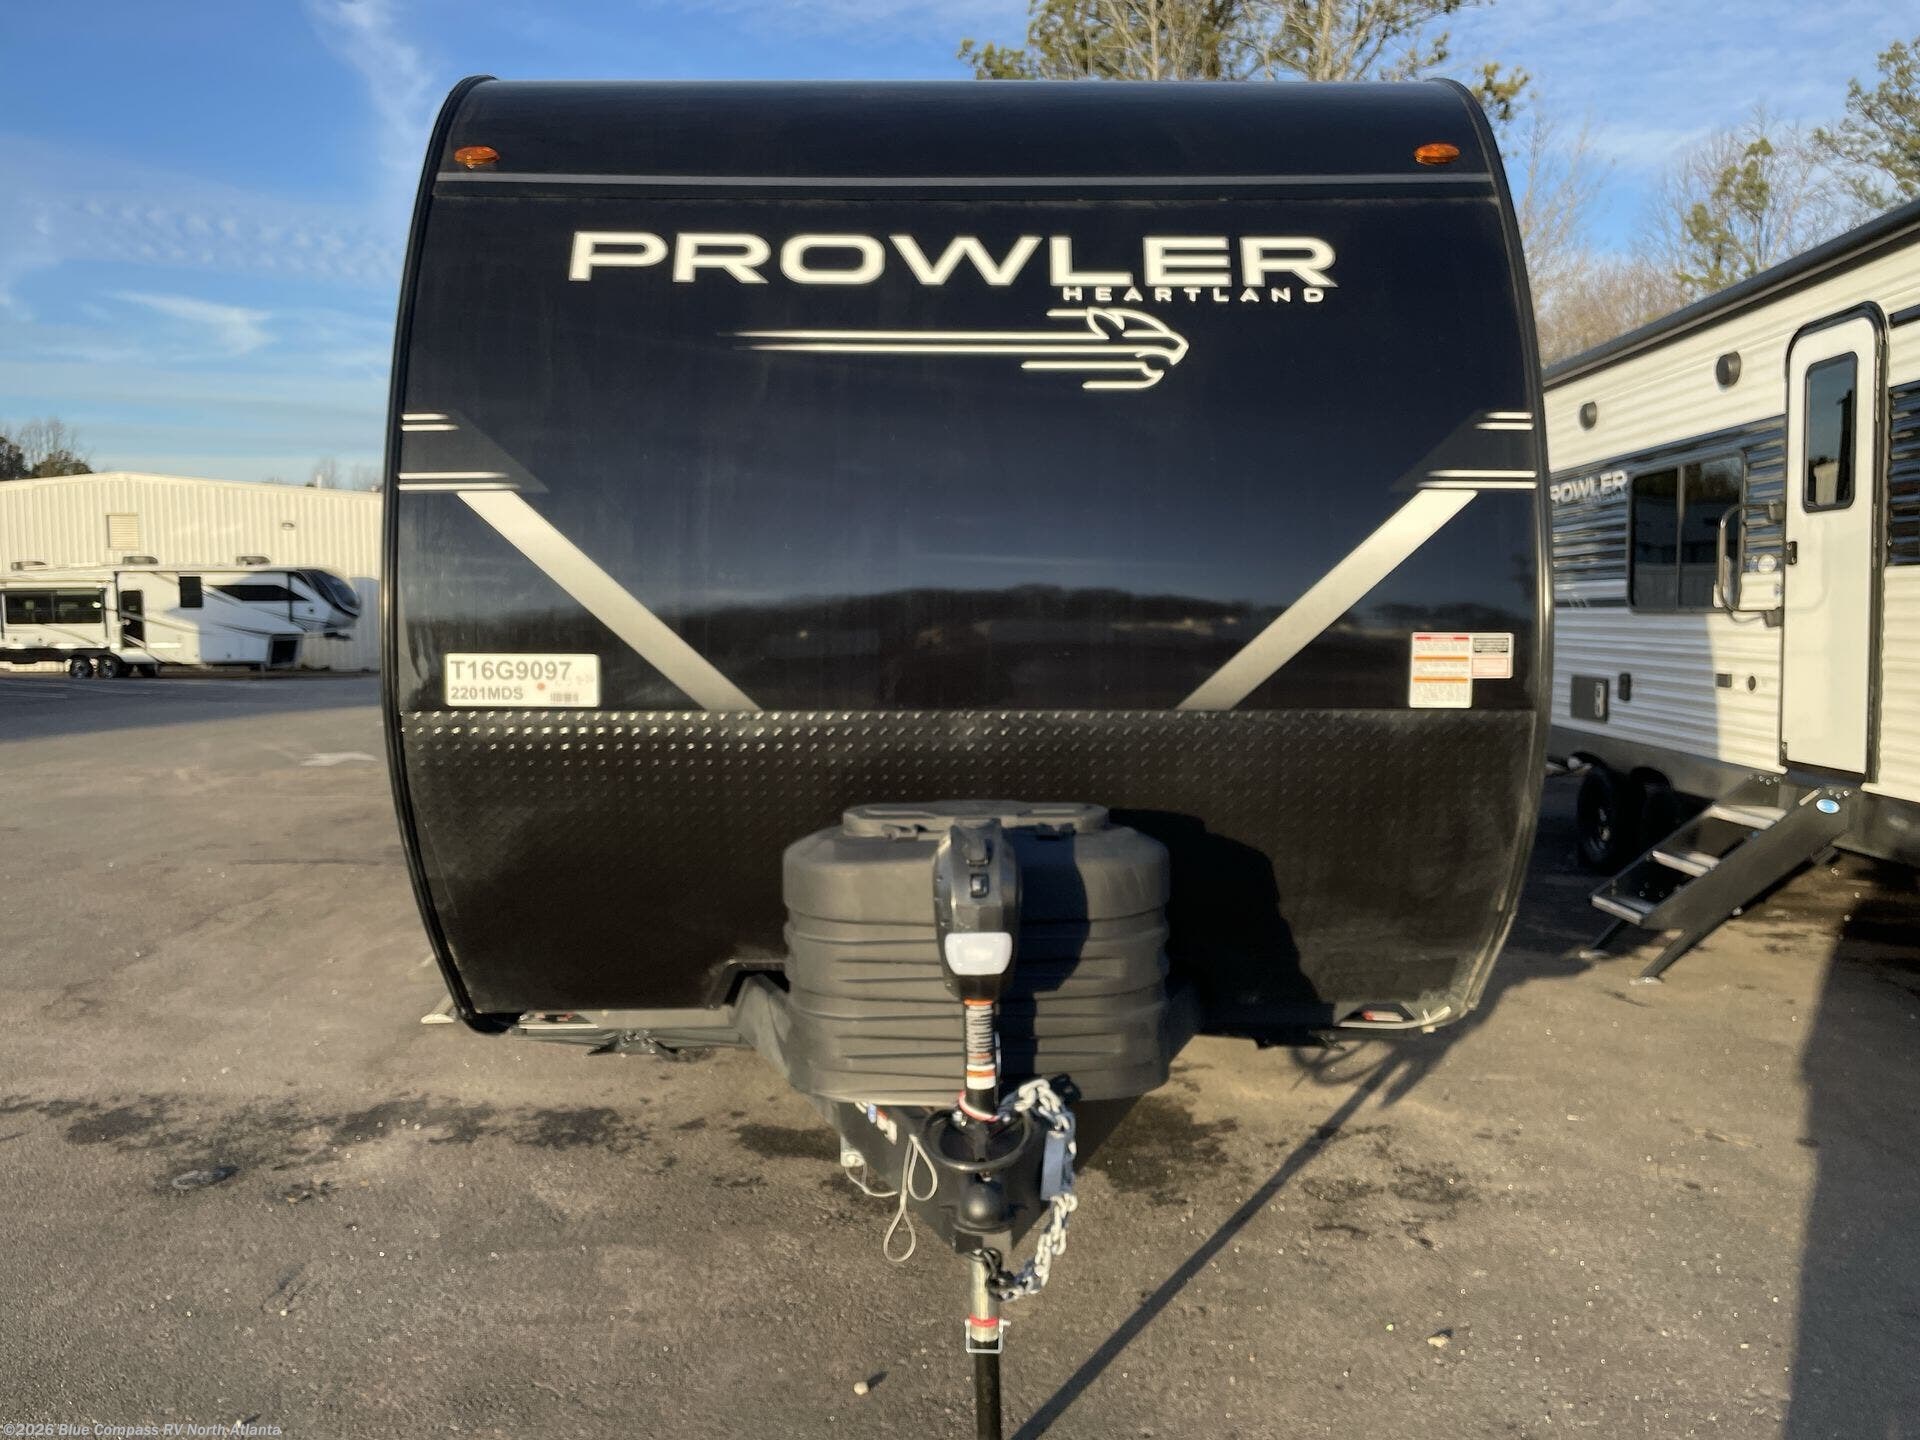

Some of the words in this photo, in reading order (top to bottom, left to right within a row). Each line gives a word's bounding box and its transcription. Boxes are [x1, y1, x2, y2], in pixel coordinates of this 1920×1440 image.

[568, 230, 1338, 287] PROWLER
[1062, 286, 1325, 304] HEARTLAND
[1550, 469, 1628, 504] ROWLER
[450, 660, 572, 681] T16G9097
[451, 686, 524, 701] 2201MDS
